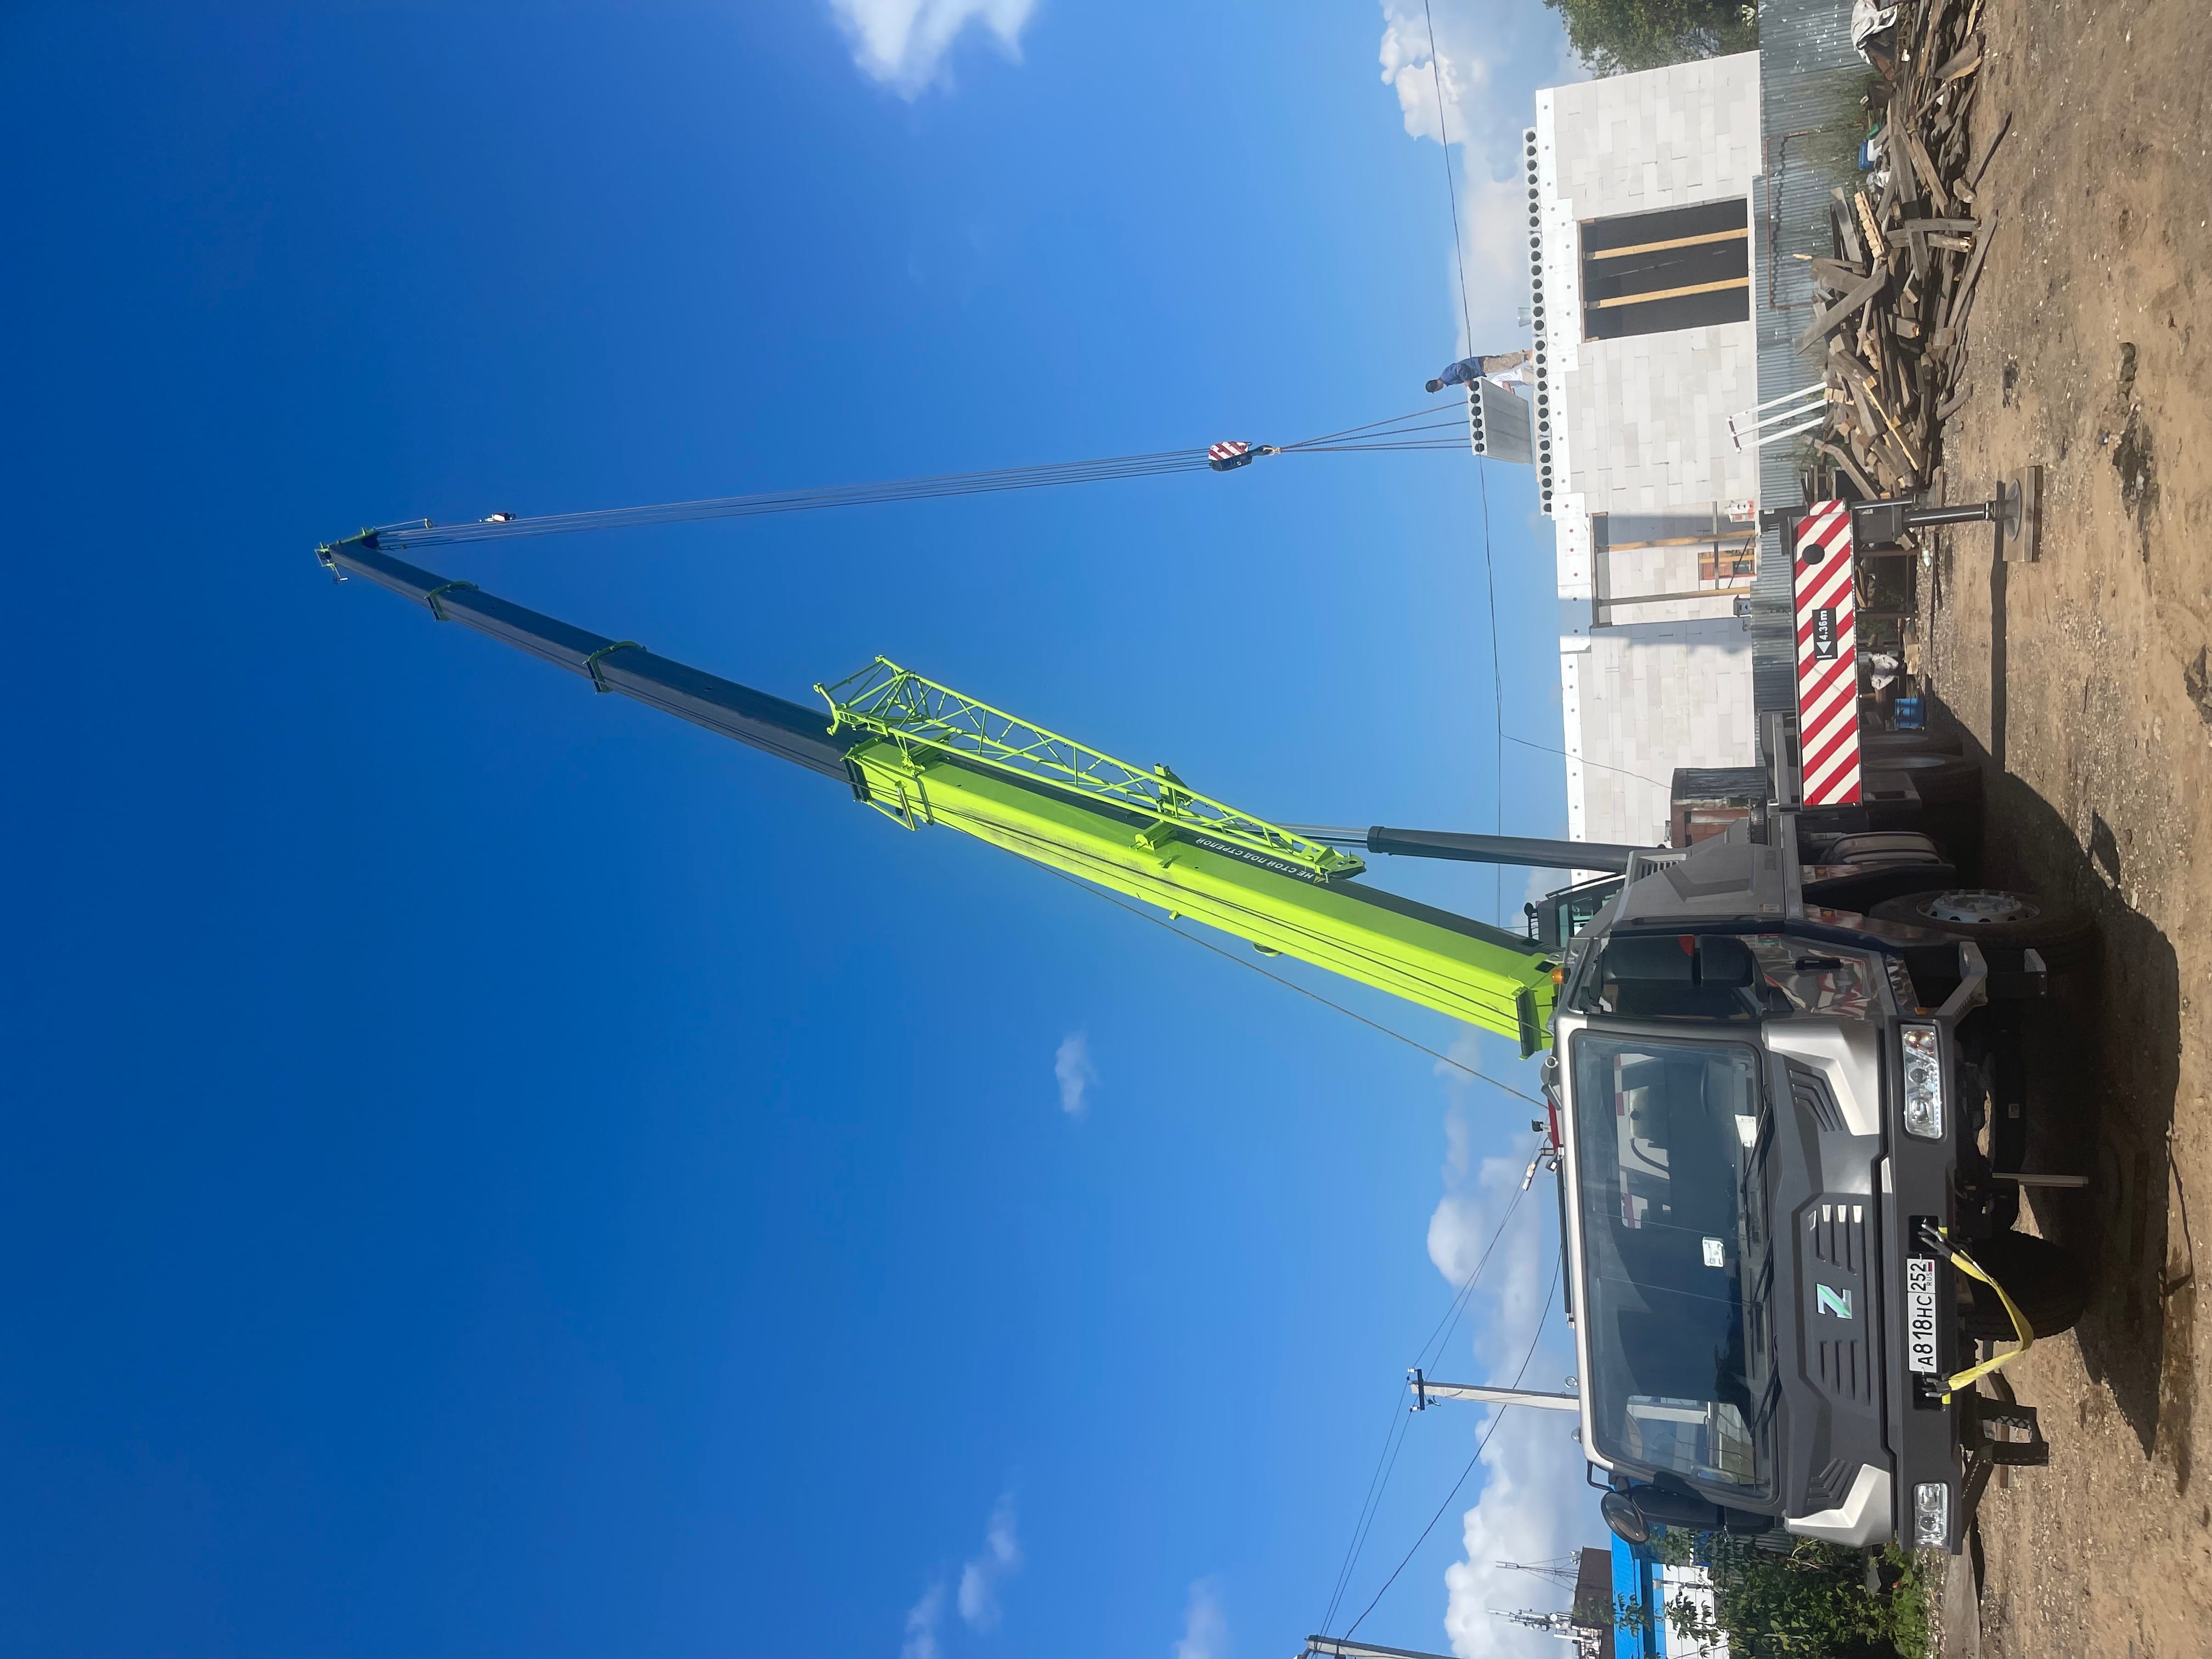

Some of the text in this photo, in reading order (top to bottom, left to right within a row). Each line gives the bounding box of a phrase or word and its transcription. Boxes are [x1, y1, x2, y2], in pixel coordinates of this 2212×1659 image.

[1819, 610, 1828, 640] 4.36m
[1195, 838, 1314, 879] НЕ СТОЙ ПОД СТРЕЛОЙ
